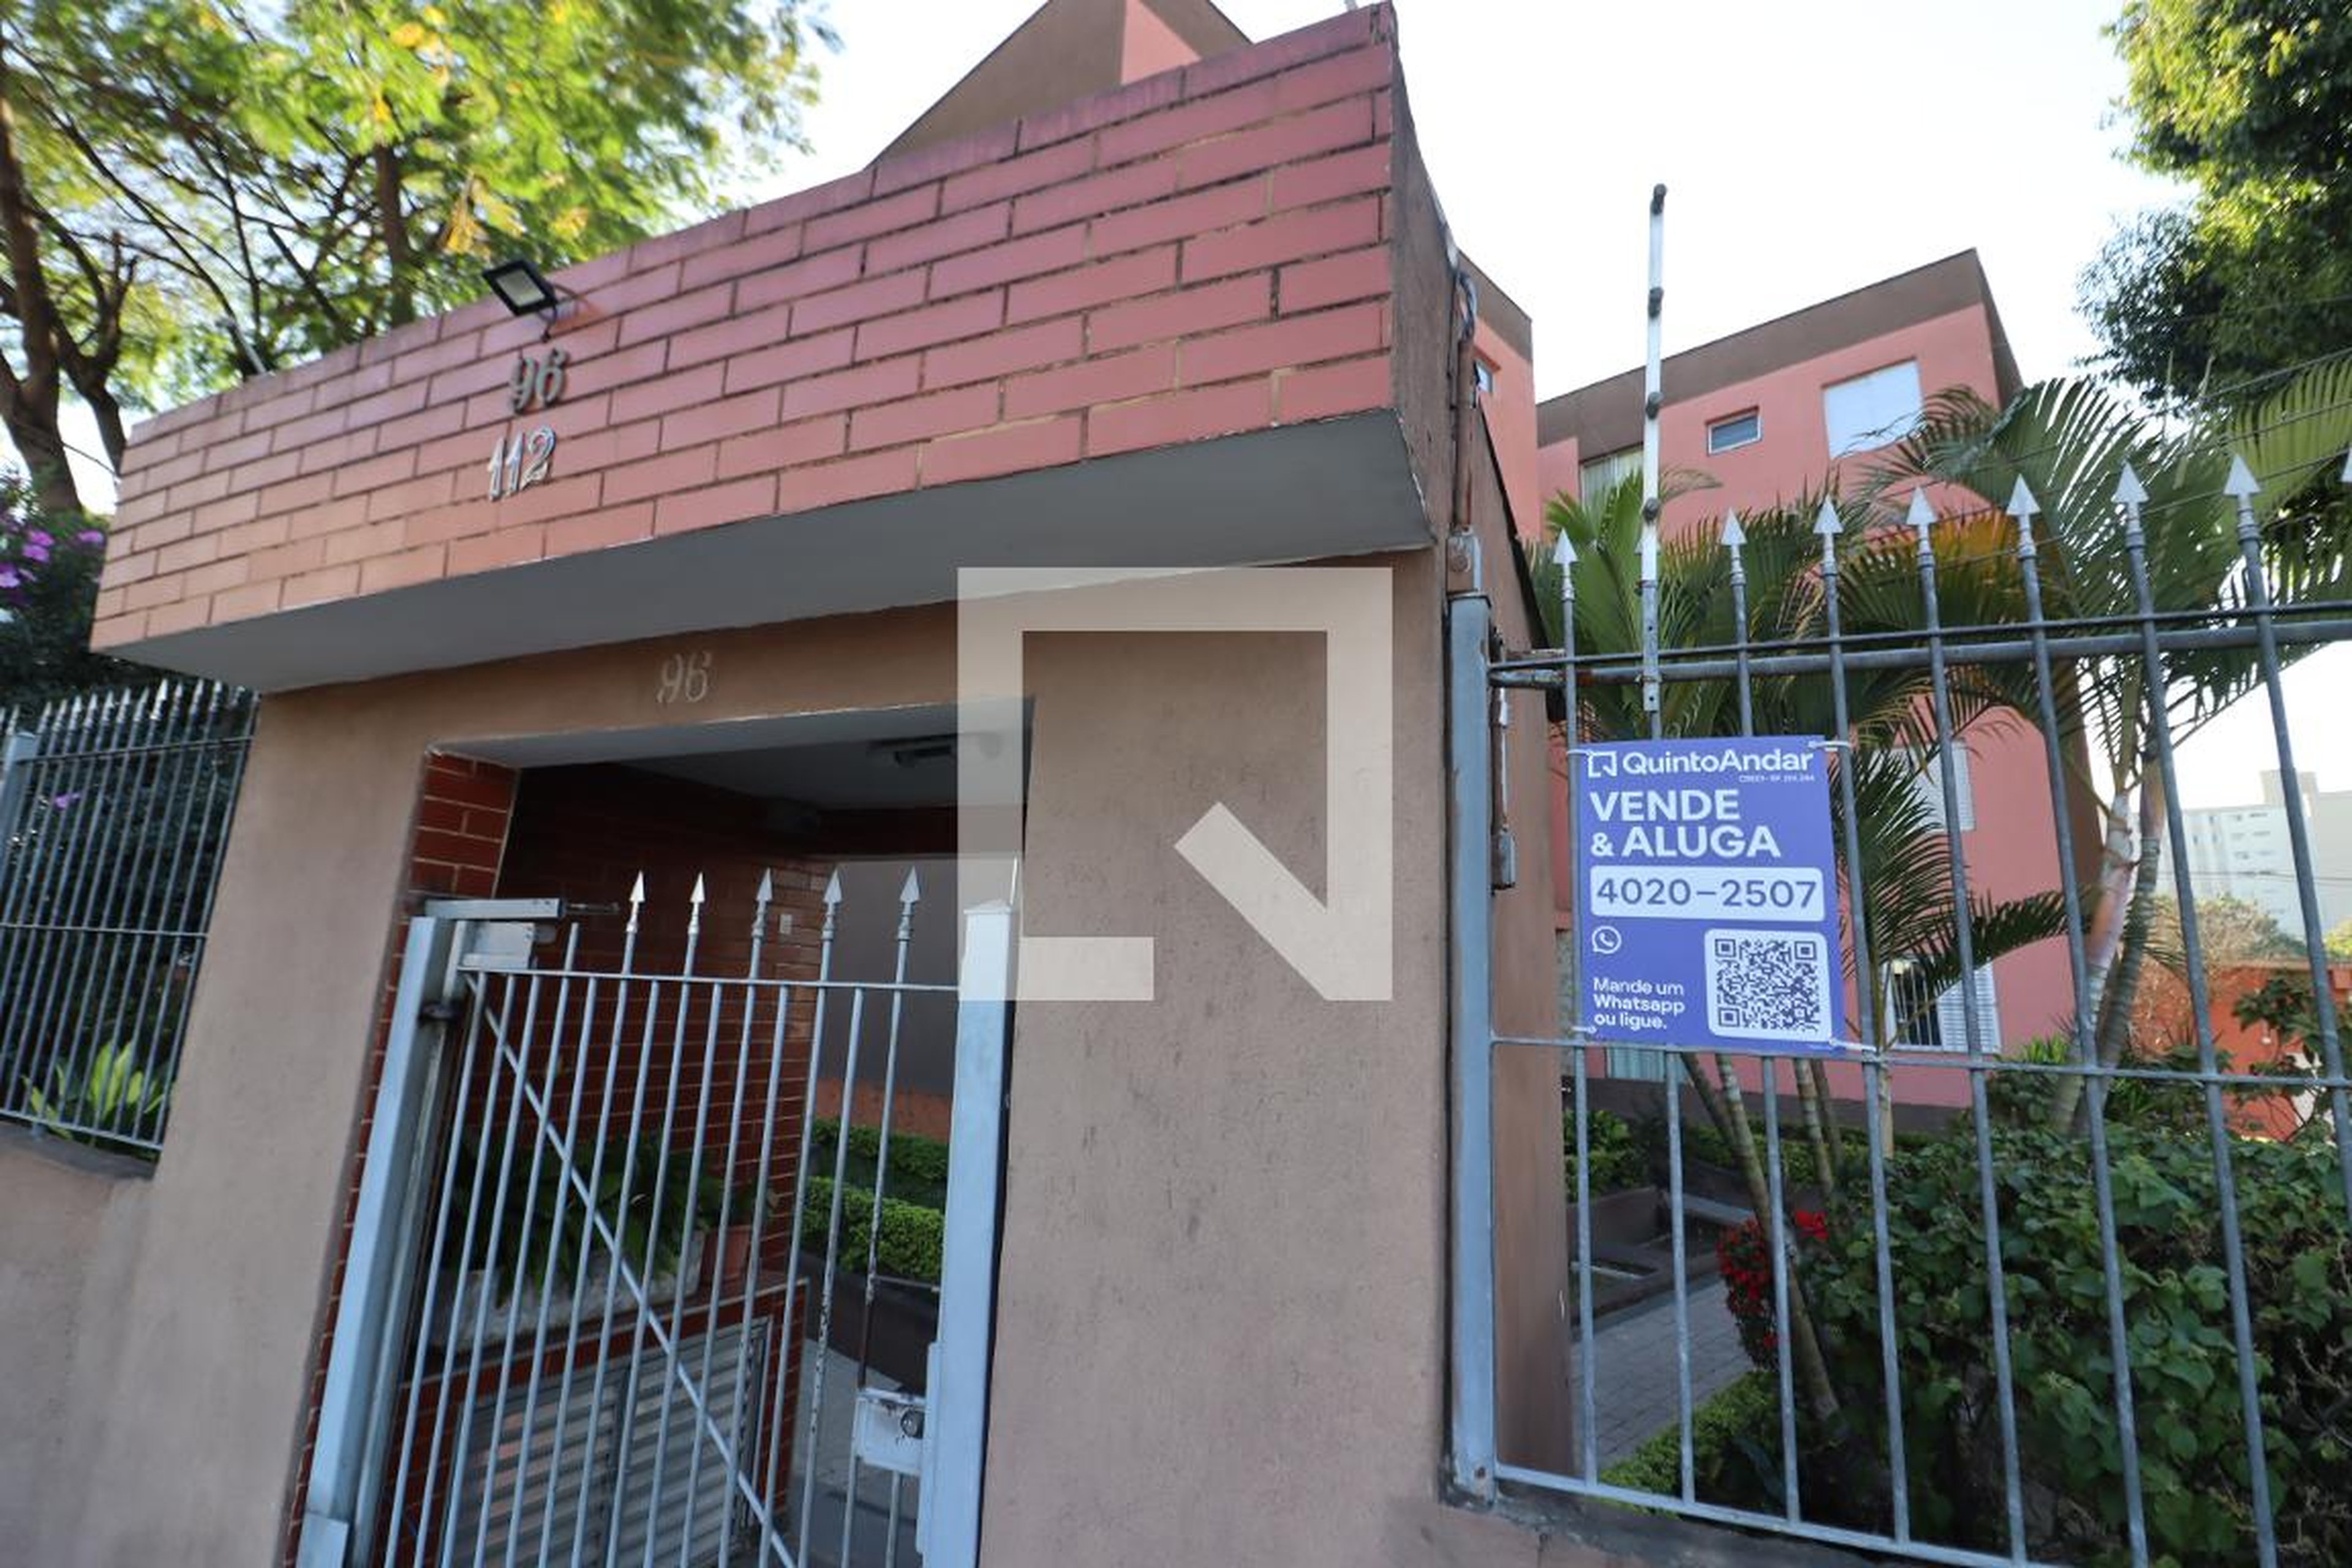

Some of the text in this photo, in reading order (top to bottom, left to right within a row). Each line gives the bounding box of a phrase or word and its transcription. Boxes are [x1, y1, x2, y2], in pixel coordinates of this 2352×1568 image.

[508, 344, 570, 414] 96
[488, 425, 556, 501] 112
[656, 650, 712, 703] 96
[1622, 748, 1814, 775] QuintoAndar
[1590, 789, 1741, 822] VENDE
[1591, 826, 1781, 858] & ALUGA
[1596, 878, 1817, 909] 4020-2507
[1593, 977, 1684, 996] Mande um
[1593, 993, 1686, 1016] Whatsapp
[1594, 1012, 1667, 1032] ou ligue.
